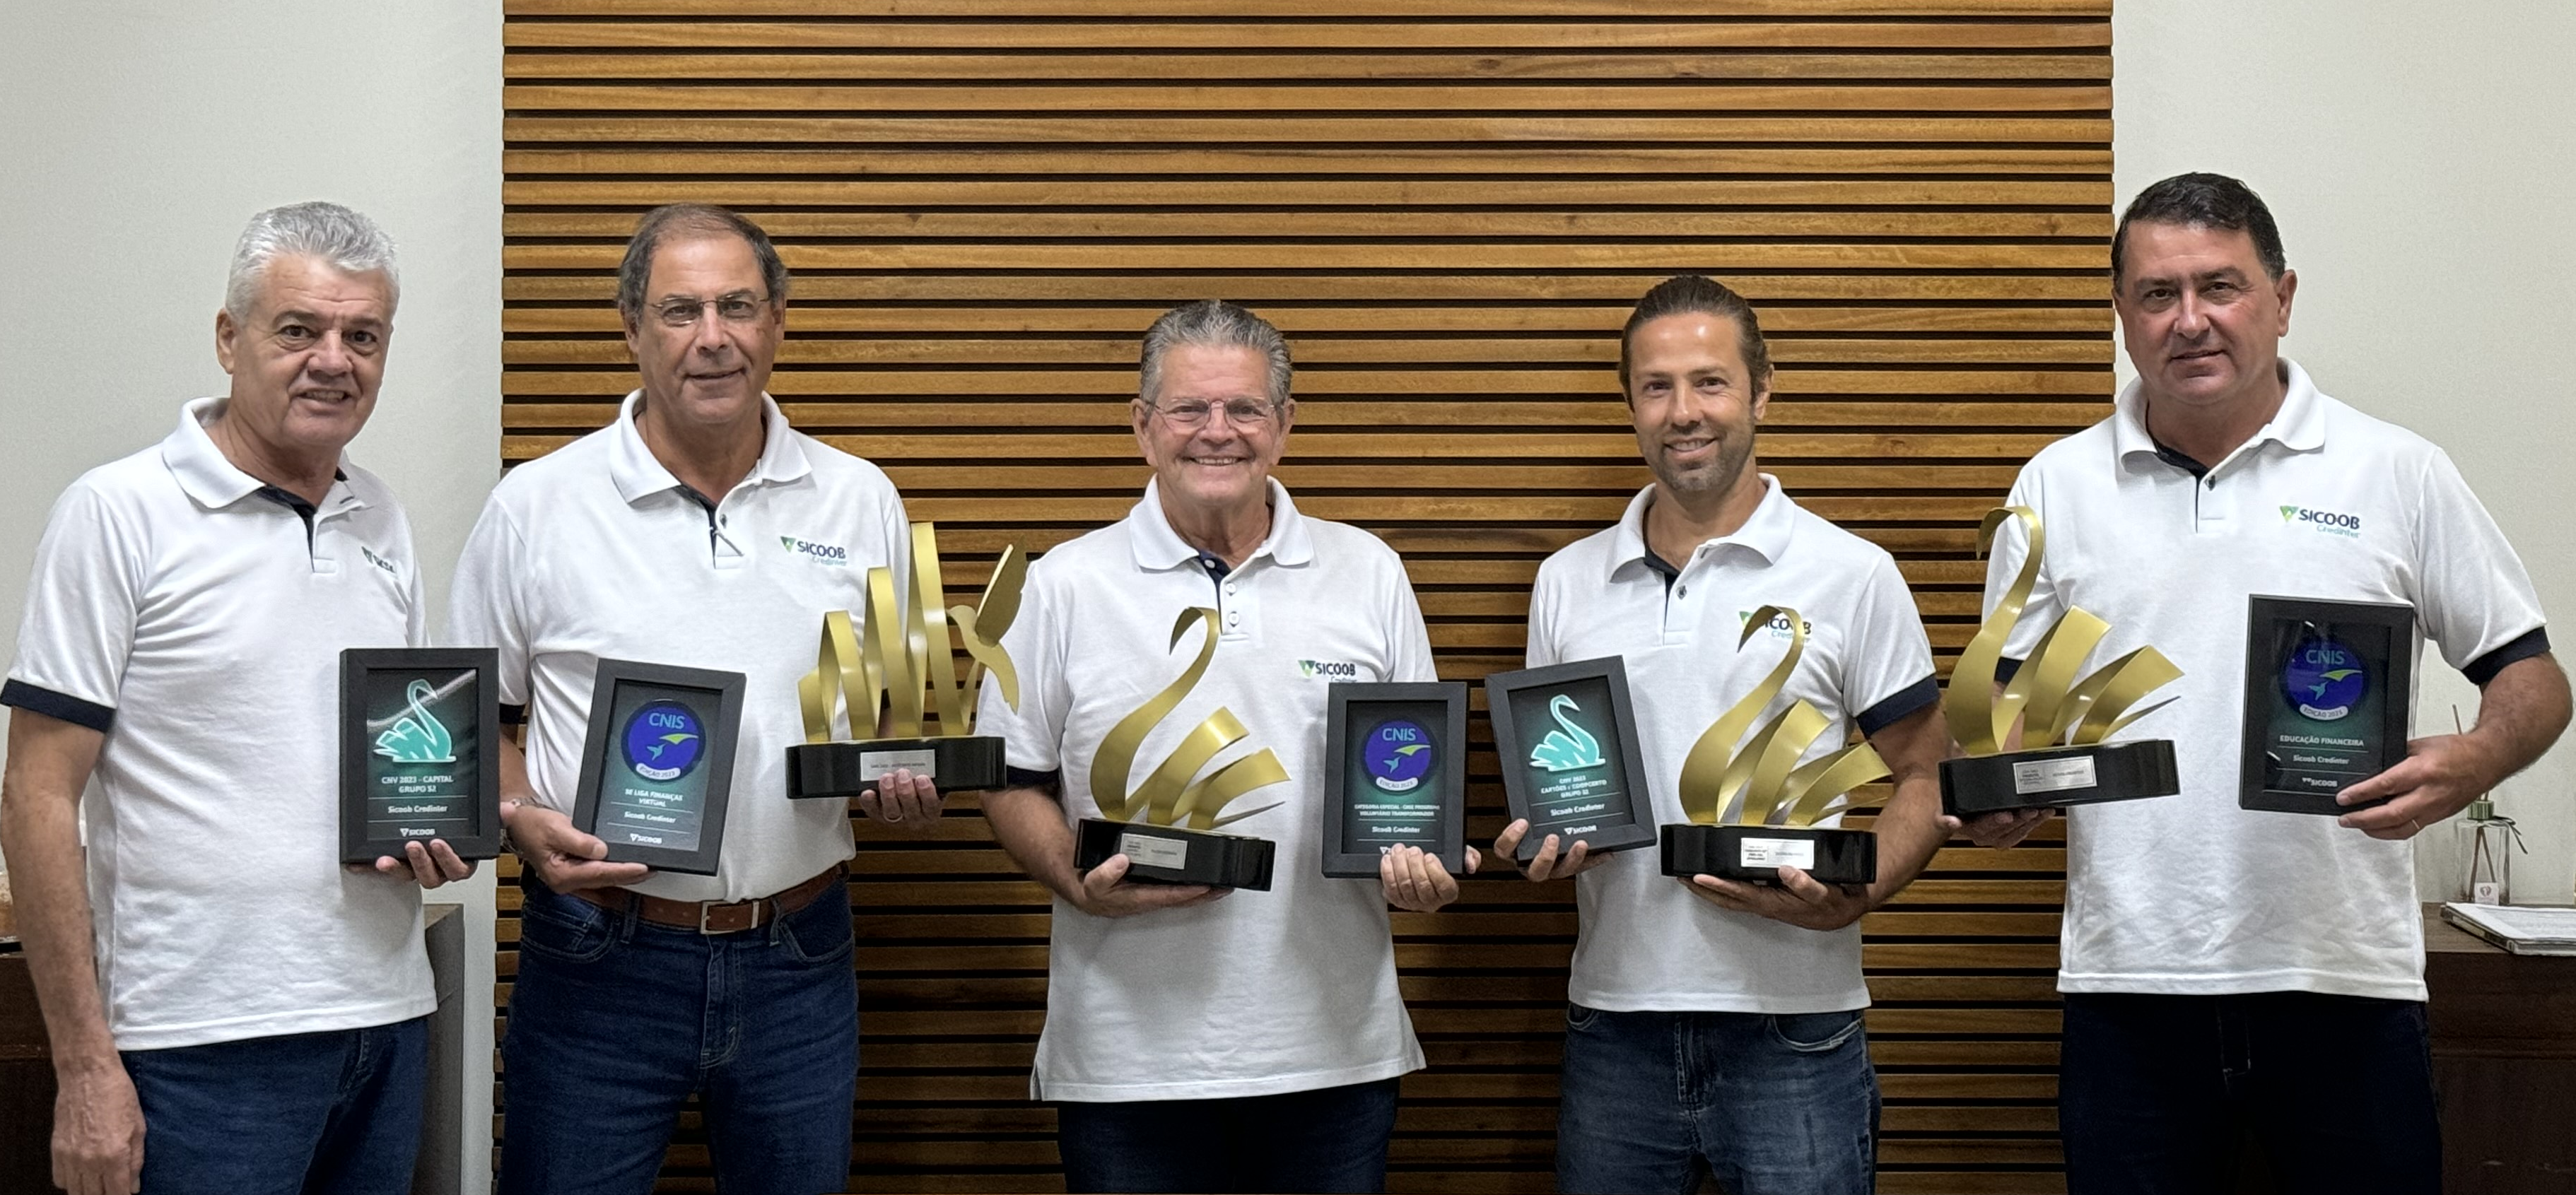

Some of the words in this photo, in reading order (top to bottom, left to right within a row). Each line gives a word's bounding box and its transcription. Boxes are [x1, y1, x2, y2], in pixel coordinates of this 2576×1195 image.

[2298, 509, 2360, 529] SICOOB
[797, 541, 846, 559] SICOOB
[2305, 649, 2345, 664] CNIS
[1315, 663, 1356, 676] SICOOB
[649, 712, 686, 729] CNIS
[1382, 728, 1417, 741] CNIS
[2280, 735, 2319, 745] EDUCAÇÃO
[2321, 738, 2365, 747] FINANCEIRA
[2293, 754, 2317, 763] Sicoob
[2317, 756, 2350, 765] Credinter
[2311, 779, 2338, 787] SICOOB
[650, 791, 684, 801] FINANÇAS
[1560, 789, 1581, 799] GRUPO
[638, 798, 666, 807] VIRTUAL
[388, 805, 413, 813] Sicoob
[1550, 807, 1574, 817] Sicoob
[1574, 803, 1605, 813] Credinter
[624, 811, 645, 820] Sicoob
[646, 813, 677, 823] Credinter
[1573, 825, 1598, 835] SICOOB
[637, 835, 662, 844] SICOOB
